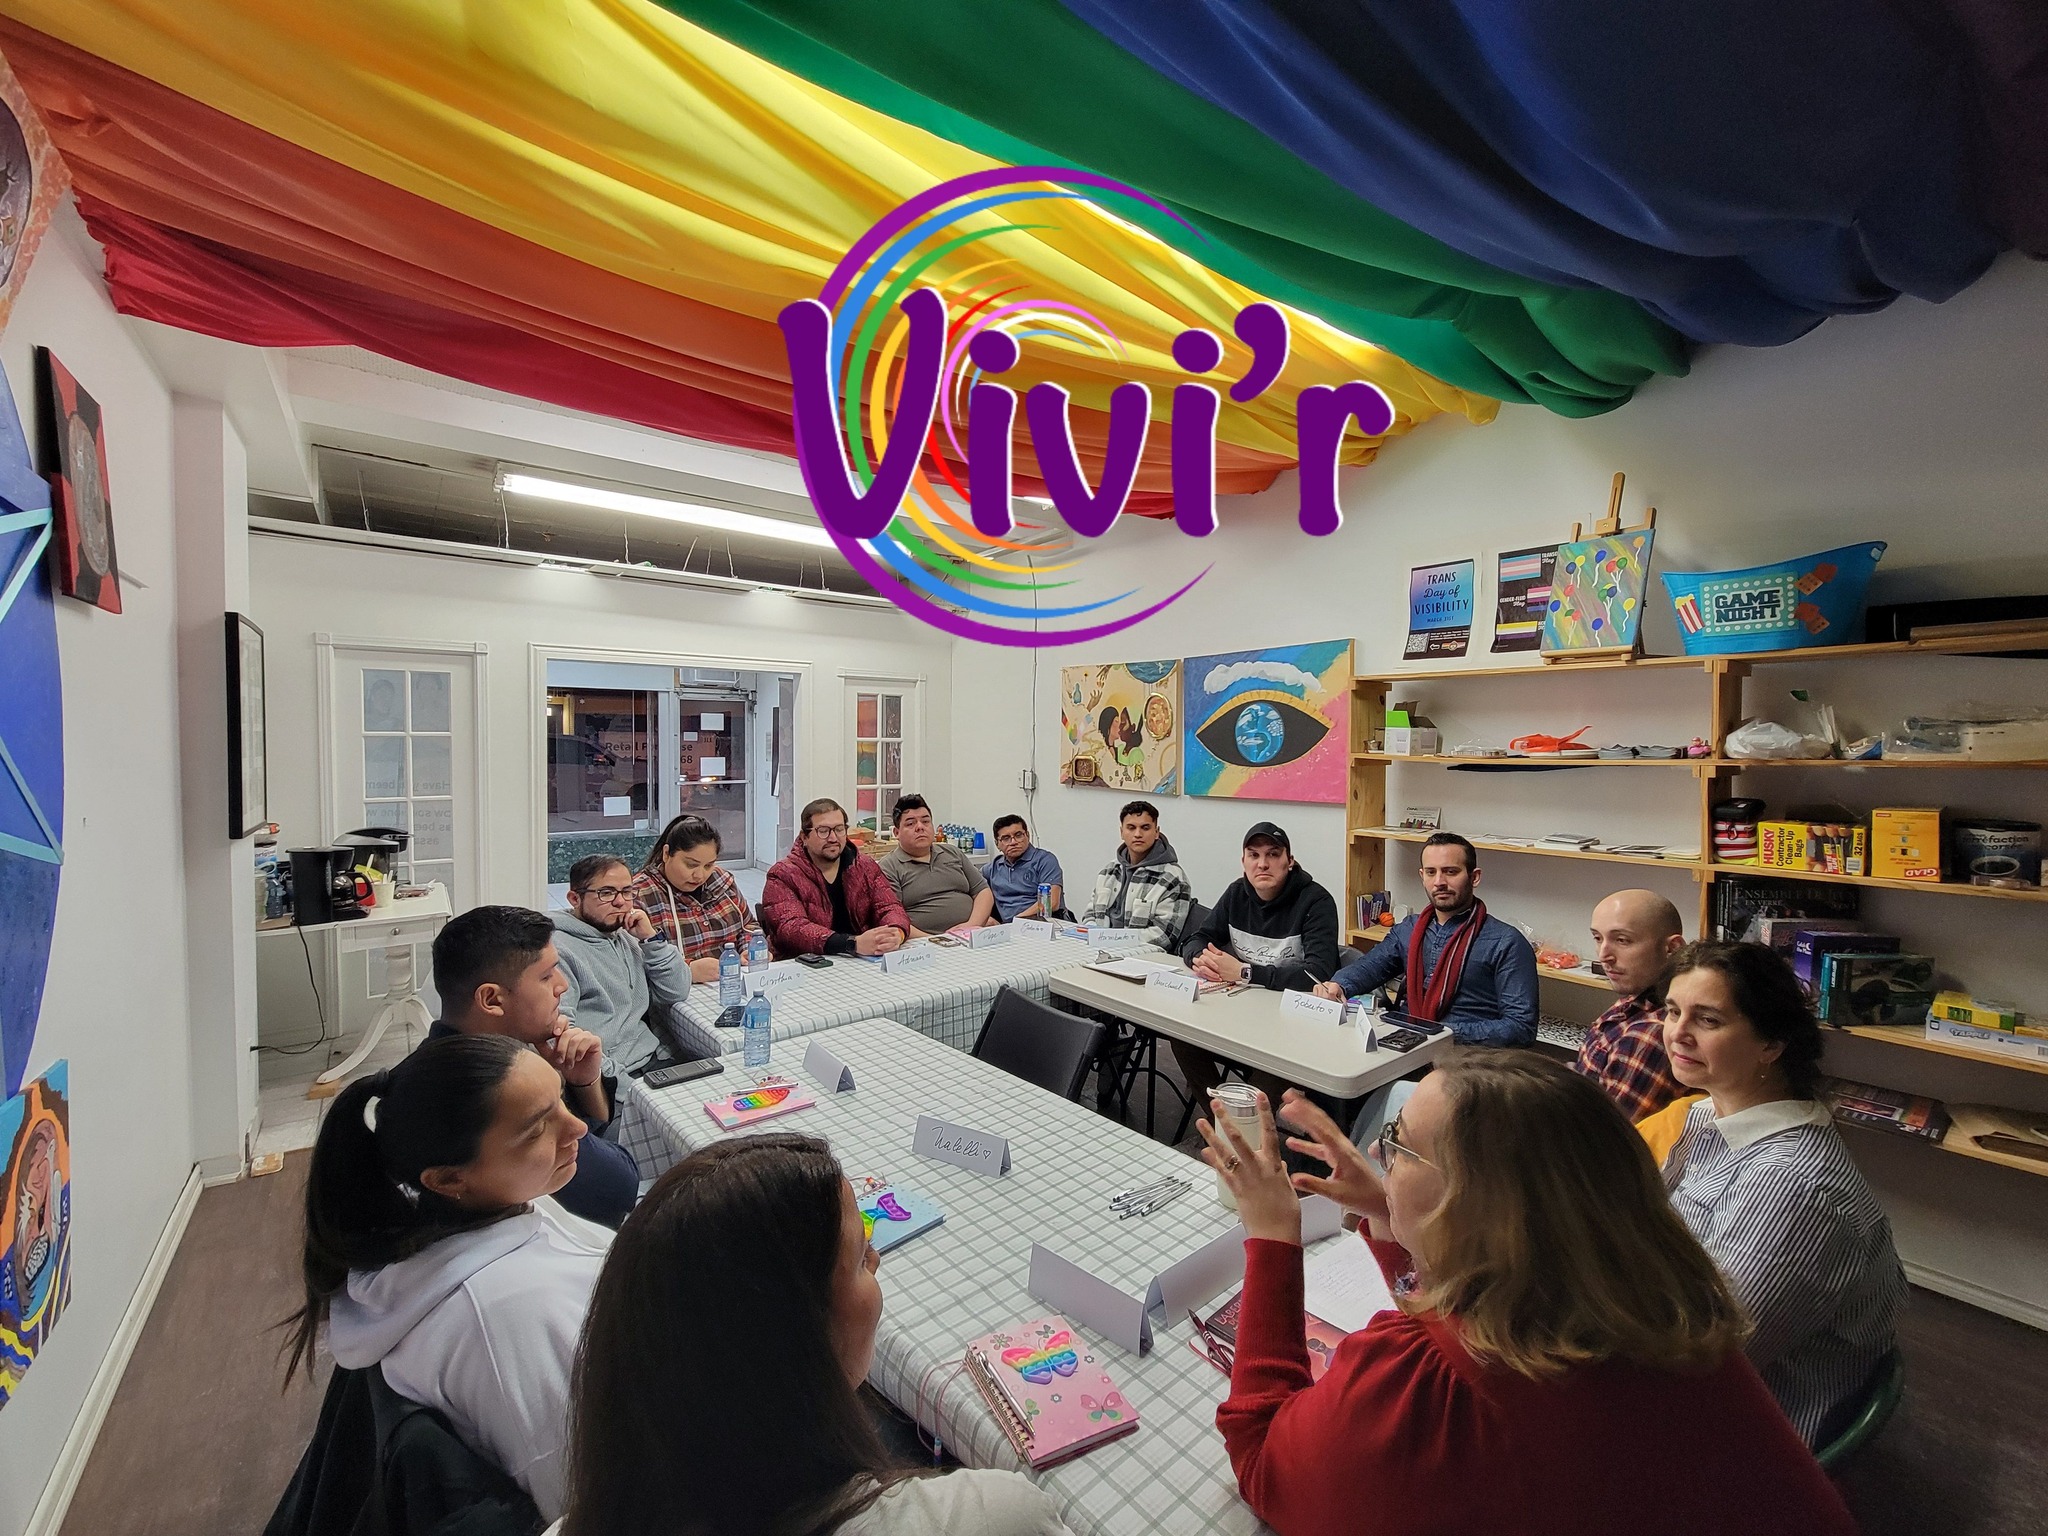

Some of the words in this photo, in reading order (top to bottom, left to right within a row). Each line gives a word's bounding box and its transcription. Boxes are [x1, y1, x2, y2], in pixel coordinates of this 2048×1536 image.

[1427, 572, 1457, 585] TRANS
[1424, 588, 1446, 600] Day
[1448, 585, 1460, 598] of
[1714, 590, 1780, 609] GAME
[1414, 599, 1469, 615] VISIBILITY
[1715, 604, 1780, 623] NIGHT
[605, 742, 638, 751] Retal
[1763, 828, 1775, 864] HUSKY
[1776, 827, 1785, 866] Contractor
[1785, 830, 1795, 865] Clean-Up
[1795, 838, 1804, 858] Bags
[1854, 846, 1862, 856] 32
[1905, 868, 1937, 877] GLAD
[1735, 887, 1800, 899] ENSEMBLE
